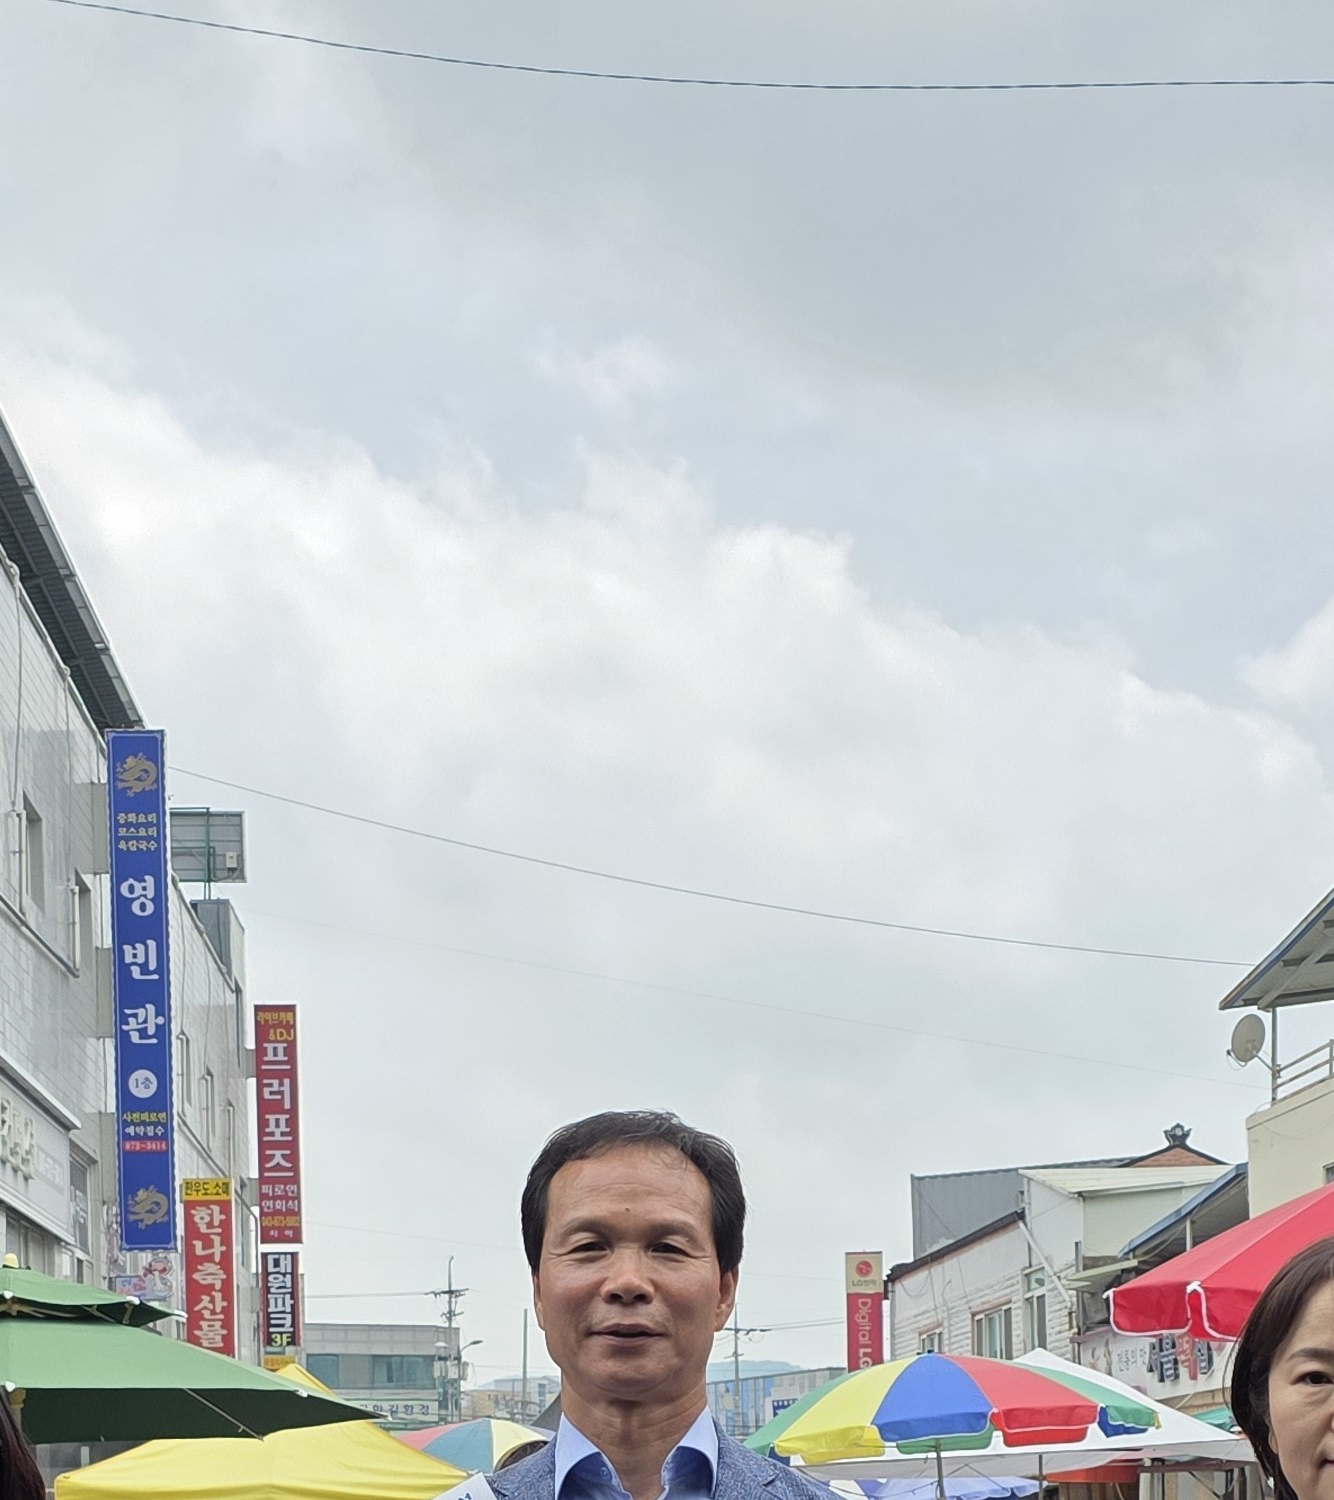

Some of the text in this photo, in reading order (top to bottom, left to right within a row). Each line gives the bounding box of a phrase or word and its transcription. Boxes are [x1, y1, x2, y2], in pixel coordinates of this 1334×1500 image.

[120, 875, 164, 1046] 영빈관
[261, 1043, 294, 1177] 프러포즈
[191, 1205, 227, 1347] 한나축산물
[267, 1254, 294, 1332] 대원파크
[855, 1299, 872, 1344] Digital
[271, 1334, 292, 1346] 3F
